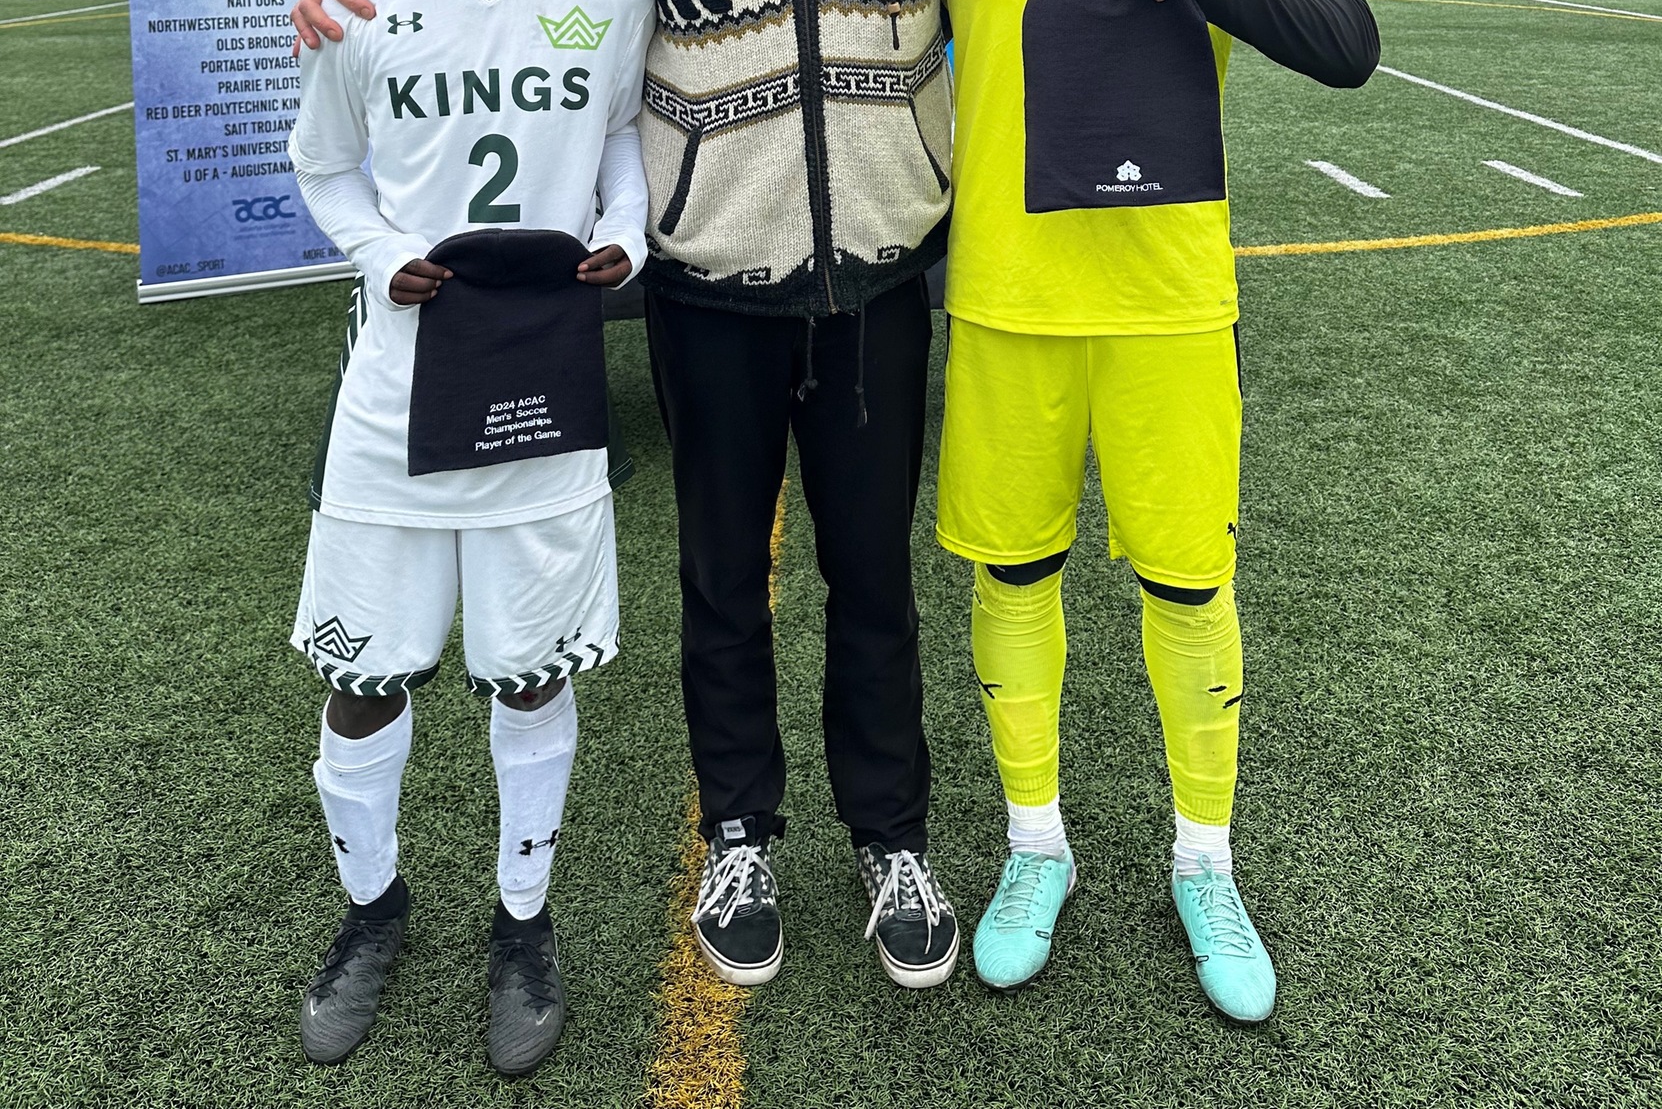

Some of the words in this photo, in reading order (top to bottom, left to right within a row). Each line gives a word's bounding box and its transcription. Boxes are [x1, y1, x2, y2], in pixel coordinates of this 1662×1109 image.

[148, 16, 239, 34] NORTHWESTERN
[216, 37, 245, 52] OLDS
[201, 58, 250, 74] PORTAGE
[218, 78, 262, 94] PRAIRIE
[265, 76, 300, 91] PILOTS
[387, 66, 591, 120] KINGS
[146, 106, 168, 121] RED
[172, 103, 202, 119] DEER
[204, 99, 279, 117] POLYTECHNIC
[224, 121, 249, 137] SAIT
[166, 148, 183, 163] ST.
[186, 143, 229, 161] MARY'S
[231, 140, 289, 158] UNIVERSIT
[183, 168, 191, 183] U
[195, 166, 210, 182] OF
[211, 165, 220, 181] A
[231, 162, 295, 180] AUGUSTANA
[468, 133, 521, 223] 2
[1096, 184, 1136, 192] POMEROY
[1136, 182, 1164, 192] HOTEL
[490, 400, 515, 413] 2024
[518, 395, 546, 408] ACAC
[486, 413, 512, 425] Men's
[516, 406, 549, 418] Soccer
[484, 416, 552, 436] Championships
[475, 440, 503, 452] Player
[505, 435, 515, 445] of
[517, 433, 533, 443] the
[534, 429, 562, 440] Game
